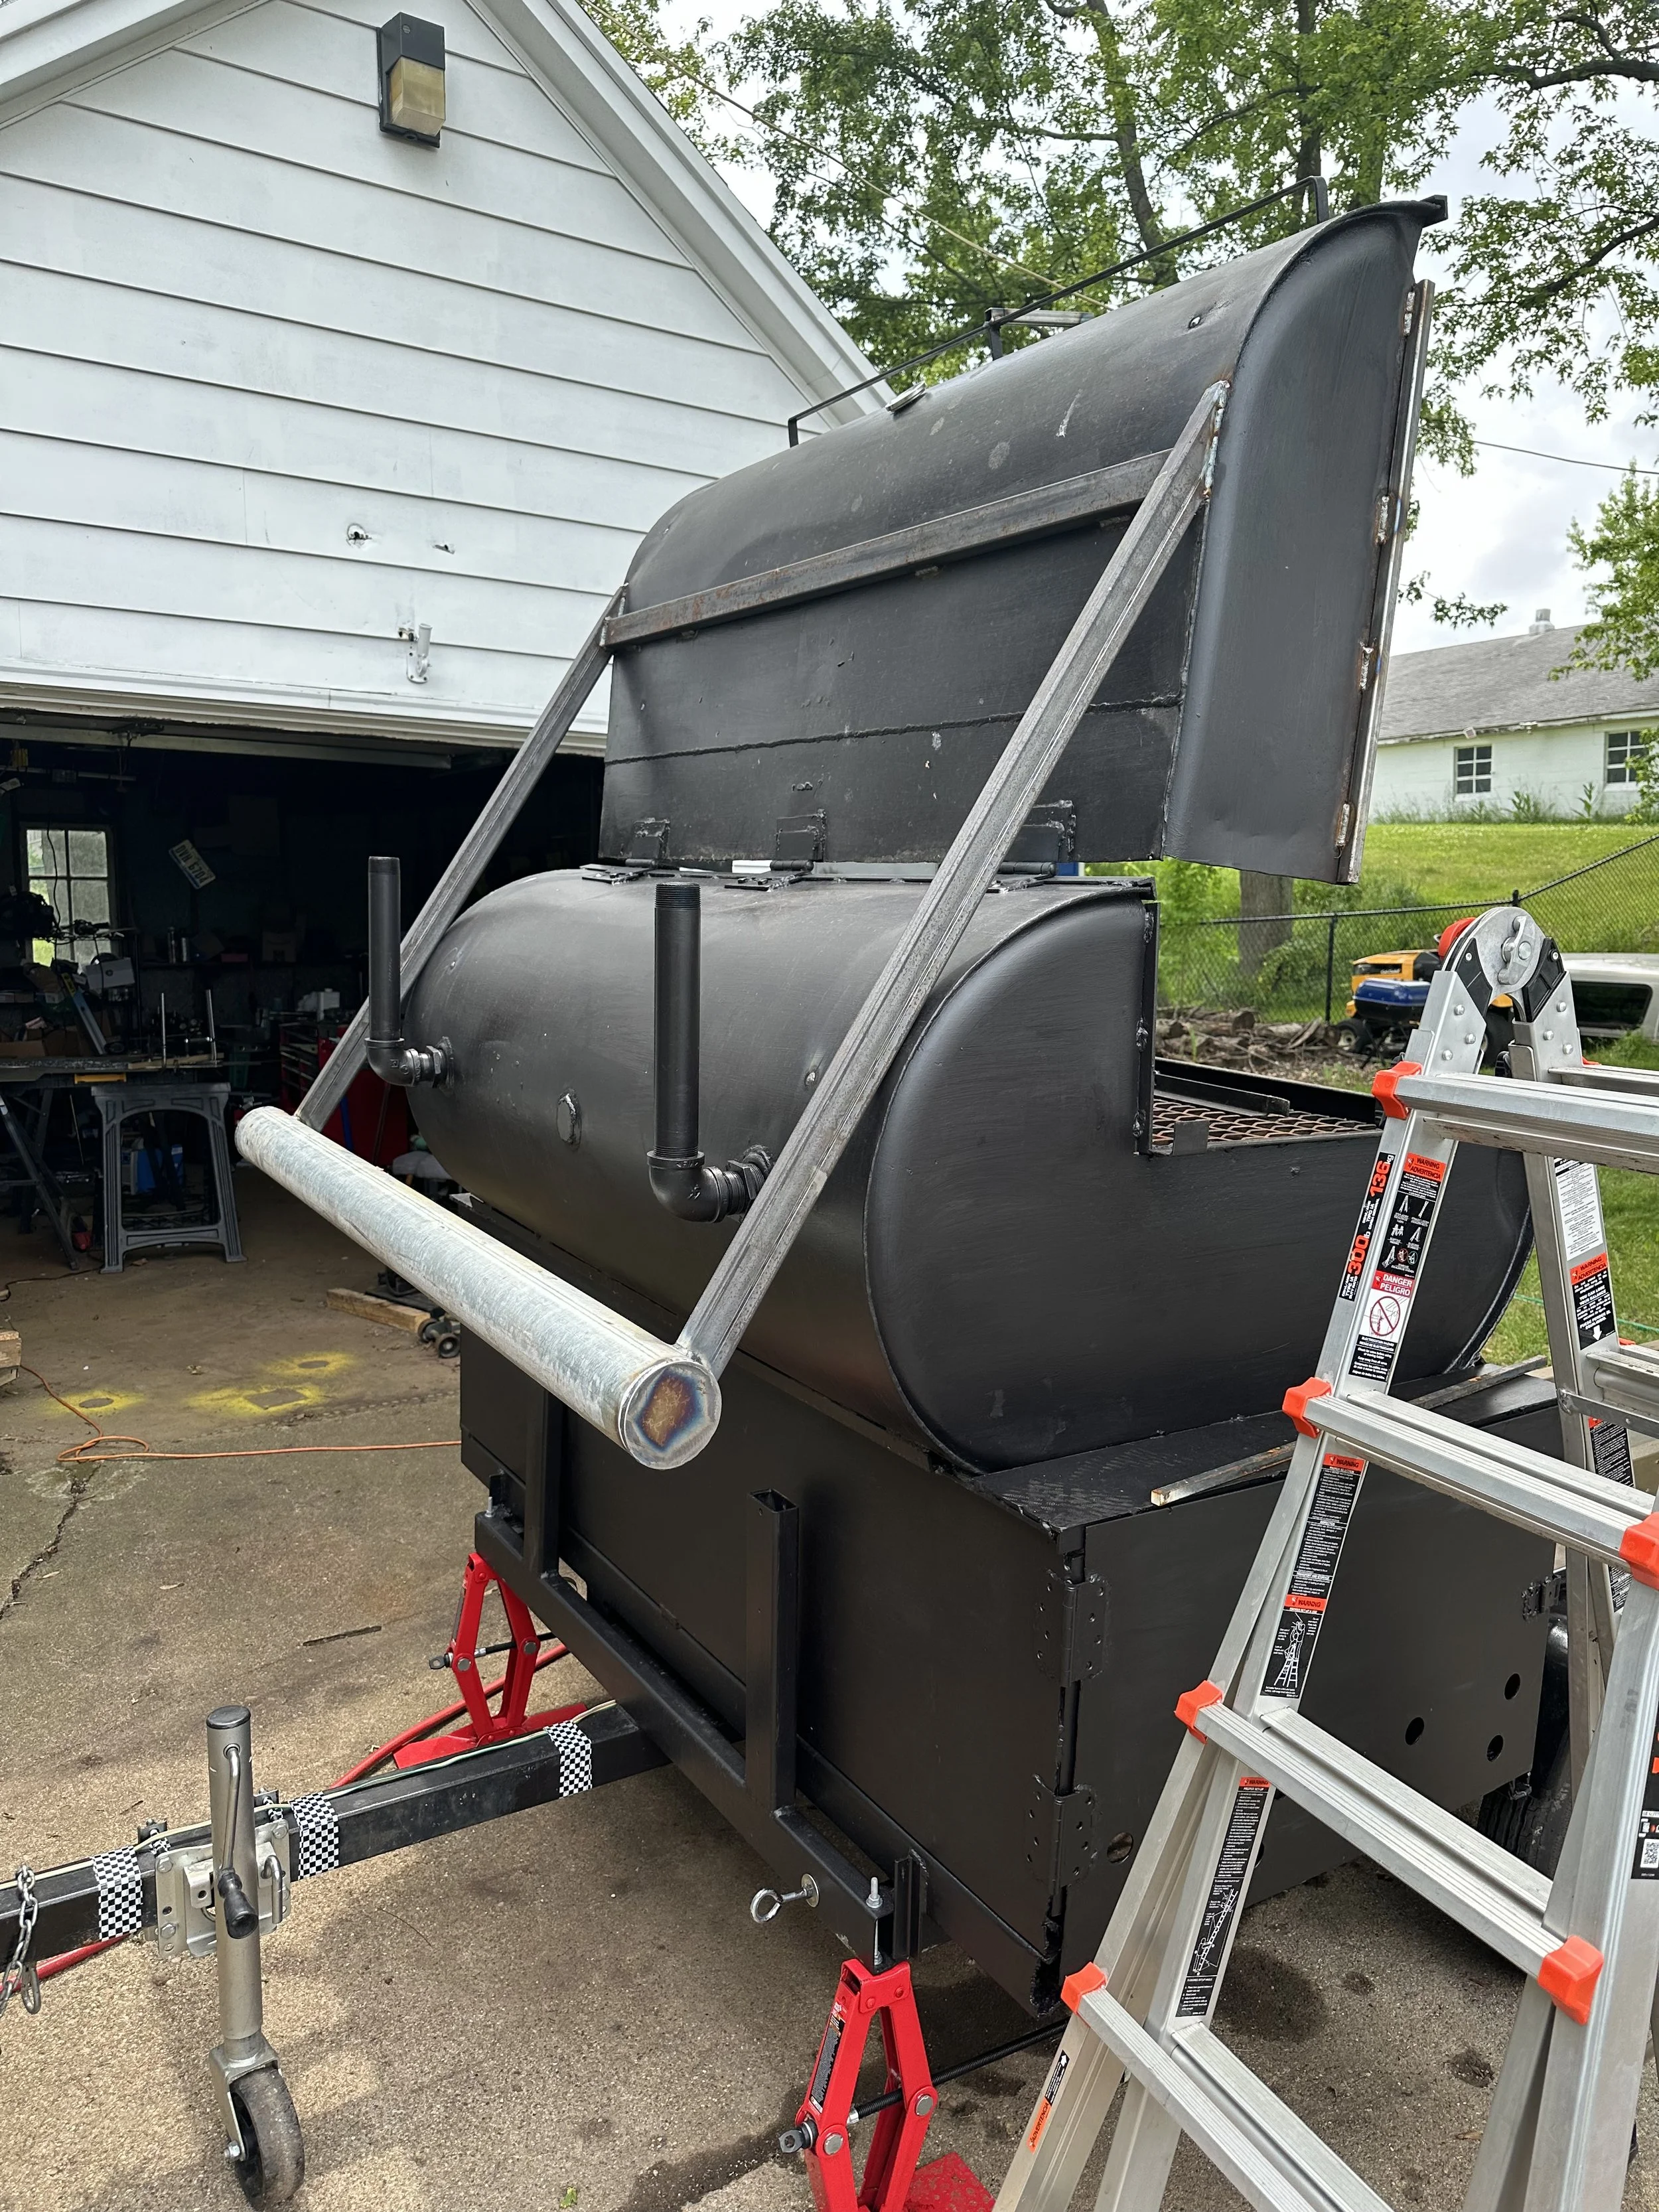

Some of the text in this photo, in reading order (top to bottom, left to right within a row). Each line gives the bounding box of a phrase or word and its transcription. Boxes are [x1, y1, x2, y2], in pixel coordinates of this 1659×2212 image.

[1416, 1157, 1440, 1169] WARNING
[1410, 1166, 1441, 1179] ADVERTENCIA
[1383, 1274, 1413, 1287] DANGER
[1380, 1282, 1411, 1296] PELIGRO
[1336, 1459, 1359, 1467] WARNING
[1033, 2102, 1048, 2141] ADVERTENCIA
